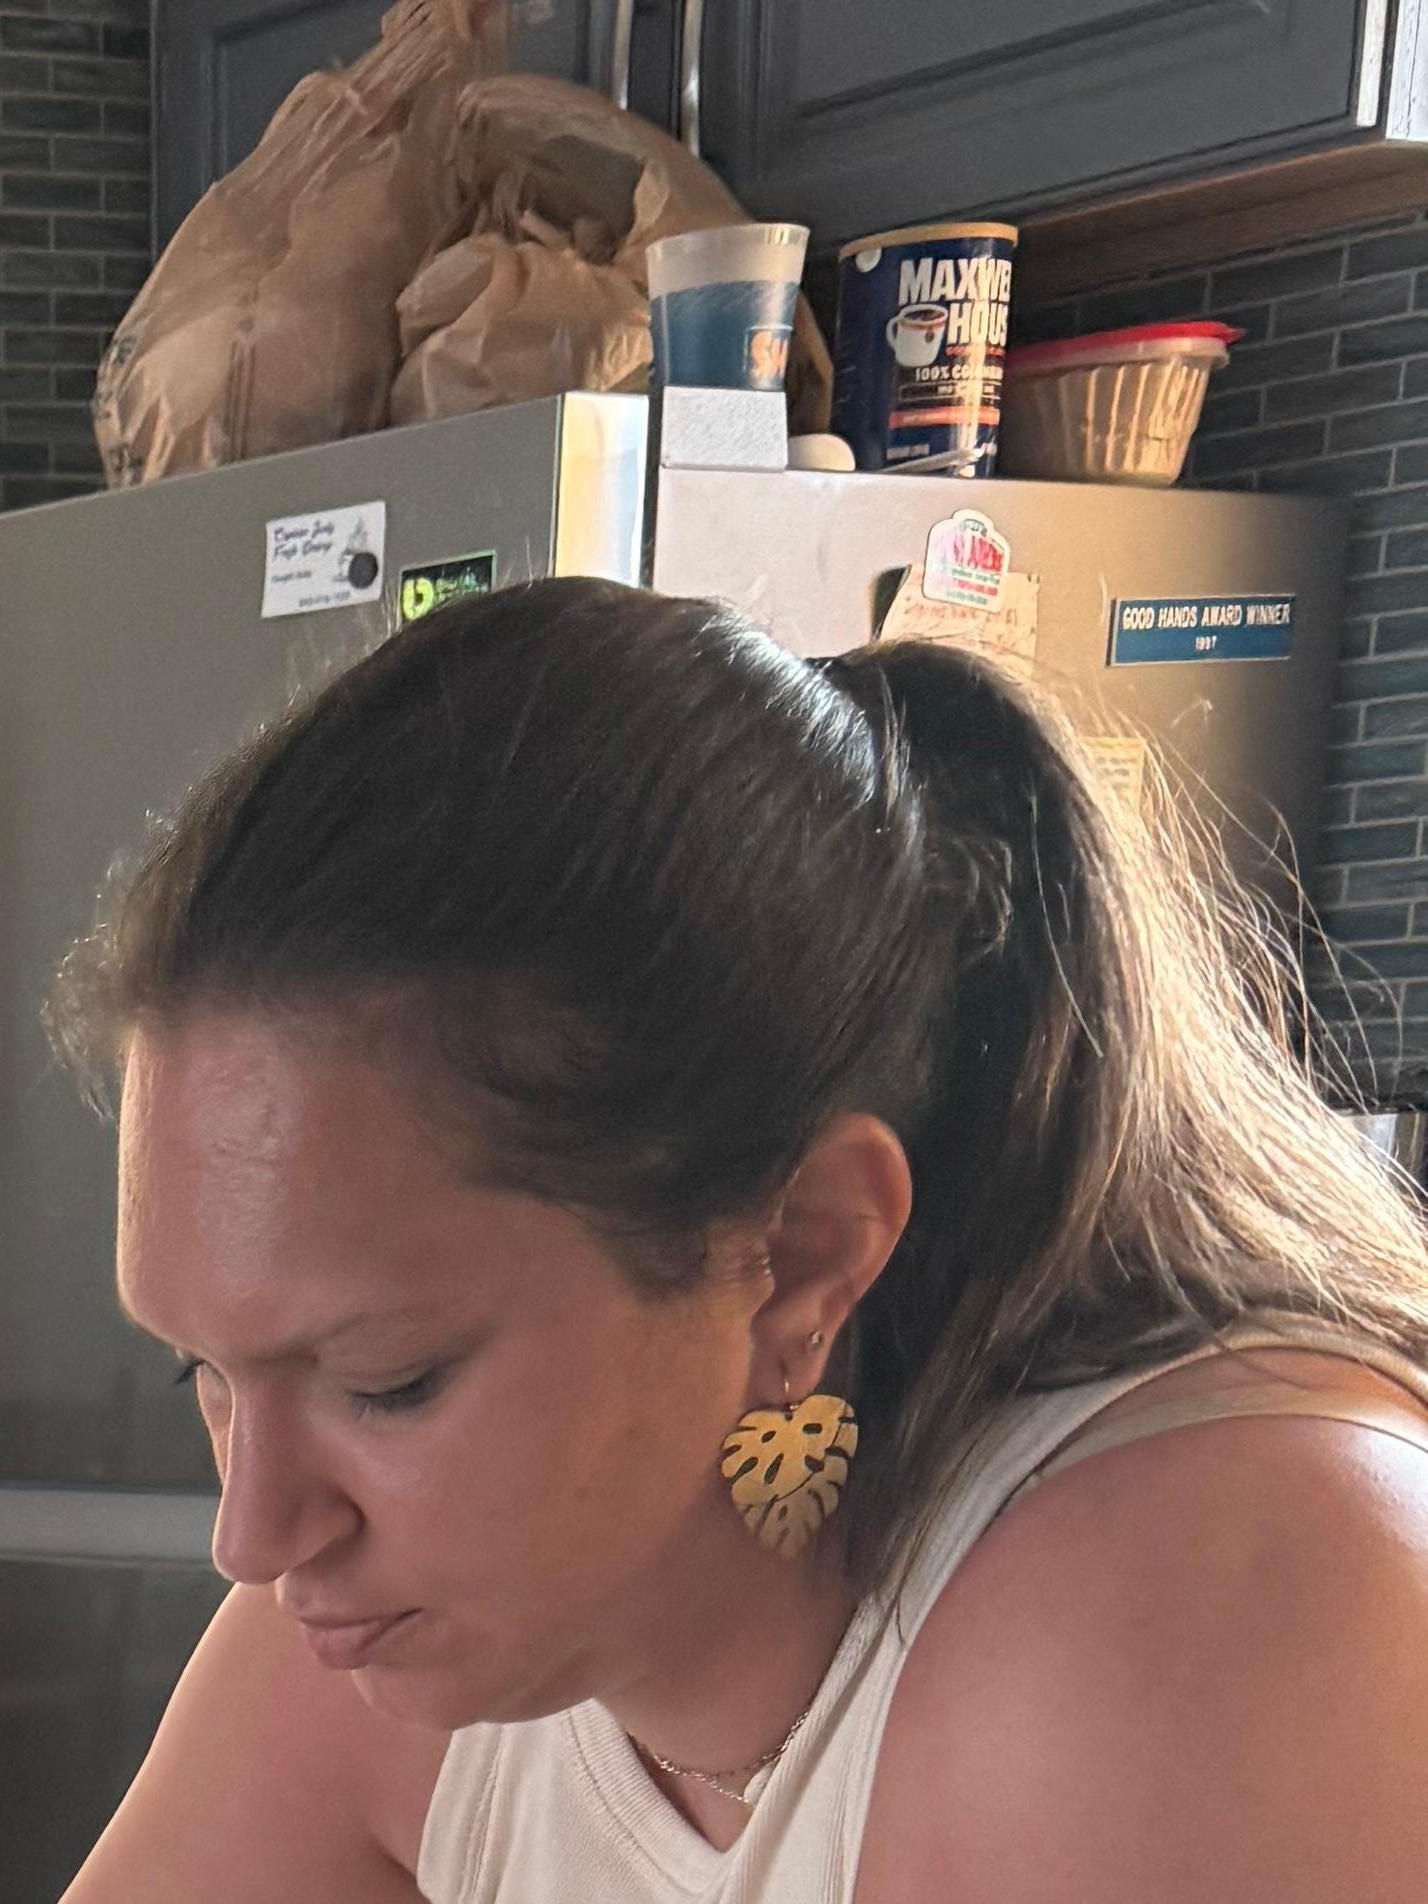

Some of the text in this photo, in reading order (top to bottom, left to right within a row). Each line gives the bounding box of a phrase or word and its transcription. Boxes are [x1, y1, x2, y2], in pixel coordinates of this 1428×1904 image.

[1122, 603, 1290, 630] GOOD HANDS AWARD WINNER
